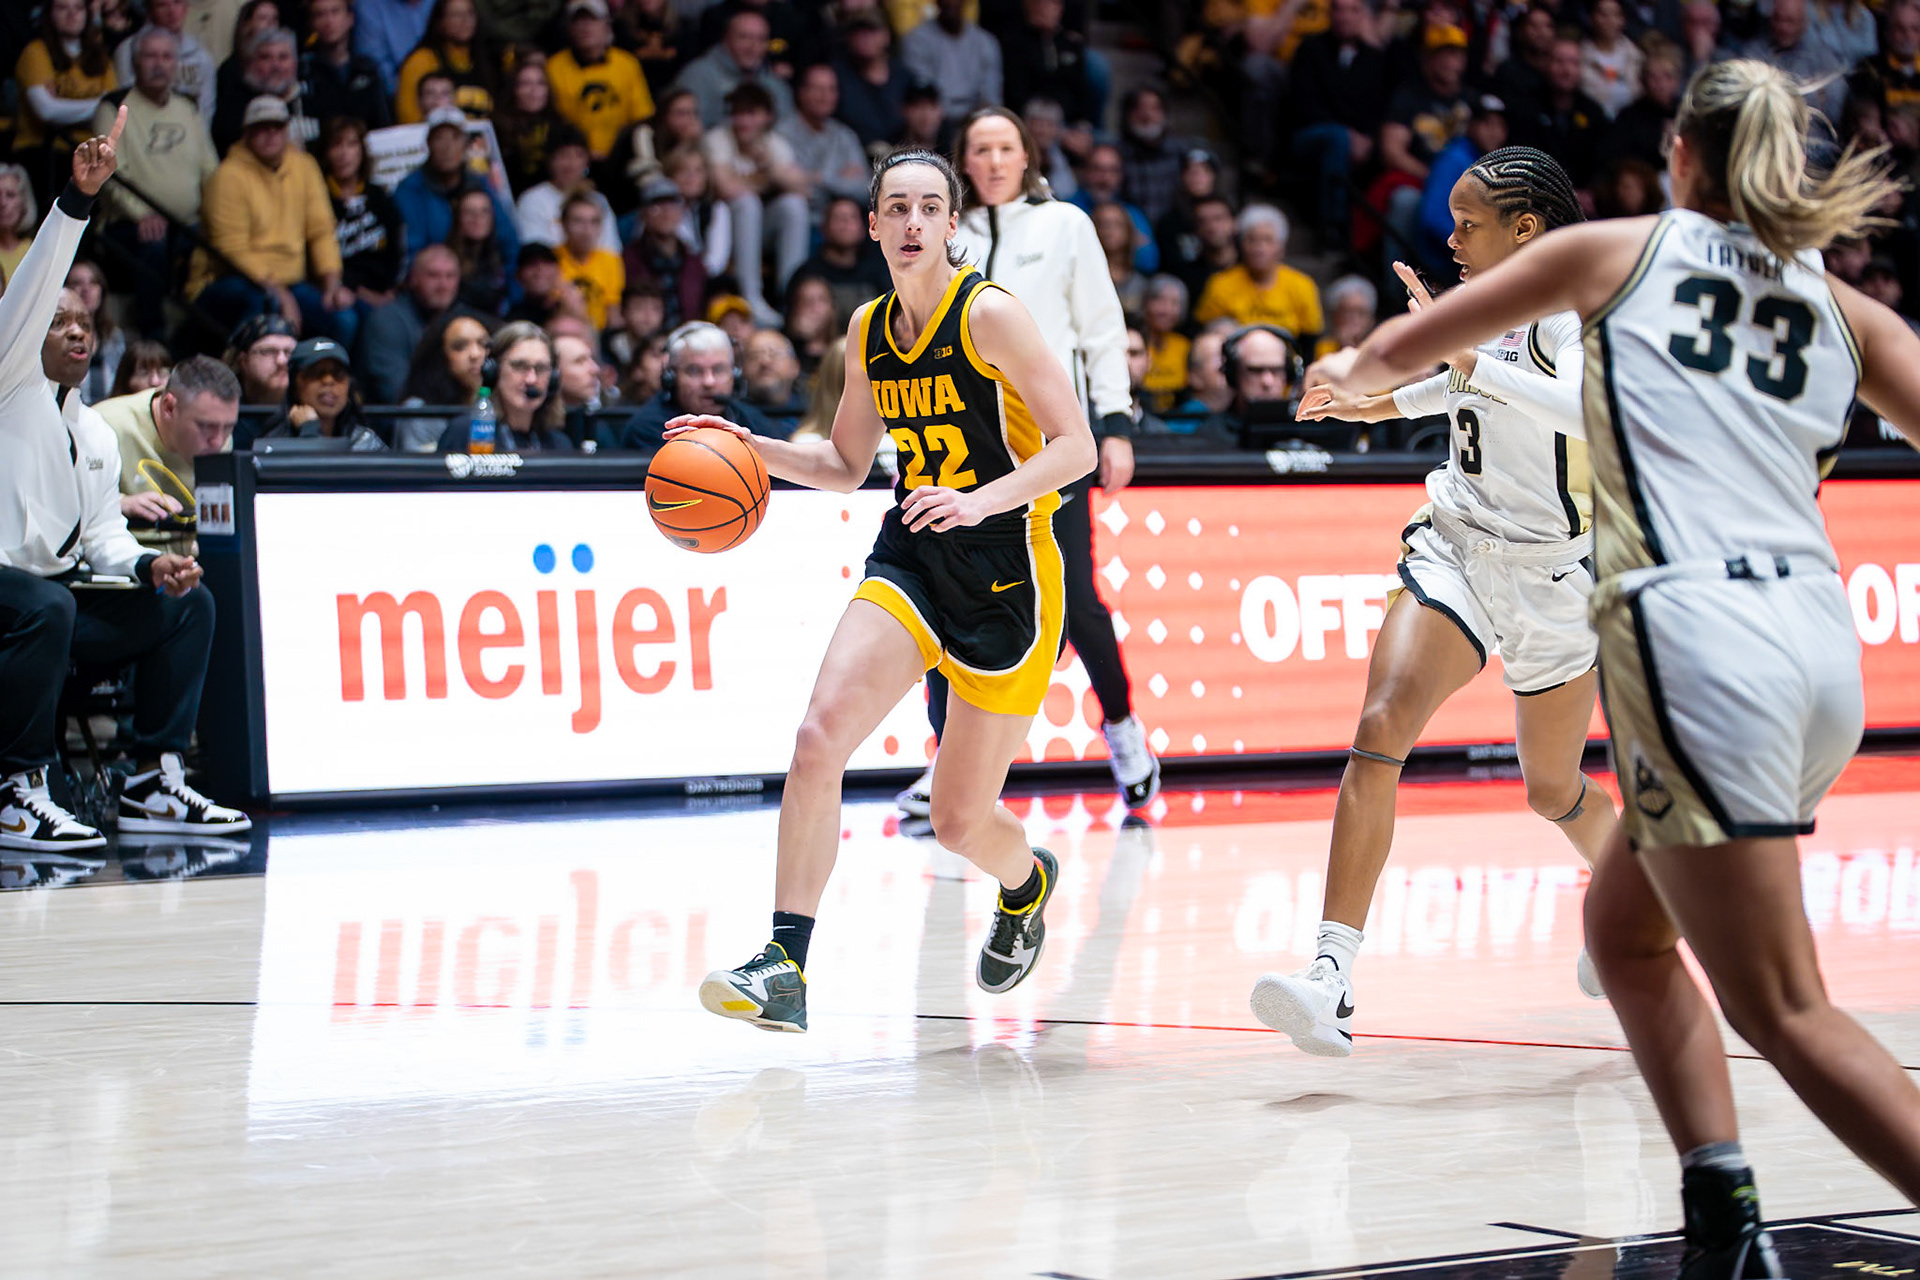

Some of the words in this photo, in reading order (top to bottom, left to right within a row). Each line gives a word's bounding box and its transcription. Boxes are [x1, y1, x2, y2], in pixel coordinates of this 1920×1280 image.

[1667, 274, 1818, 402] 33
[871, 374, 967, 419] IOWA
[889, 424, 978, 491] 22
[1456, 407, 1483, 476] 3
[336, 543, 728, 734] meijer
